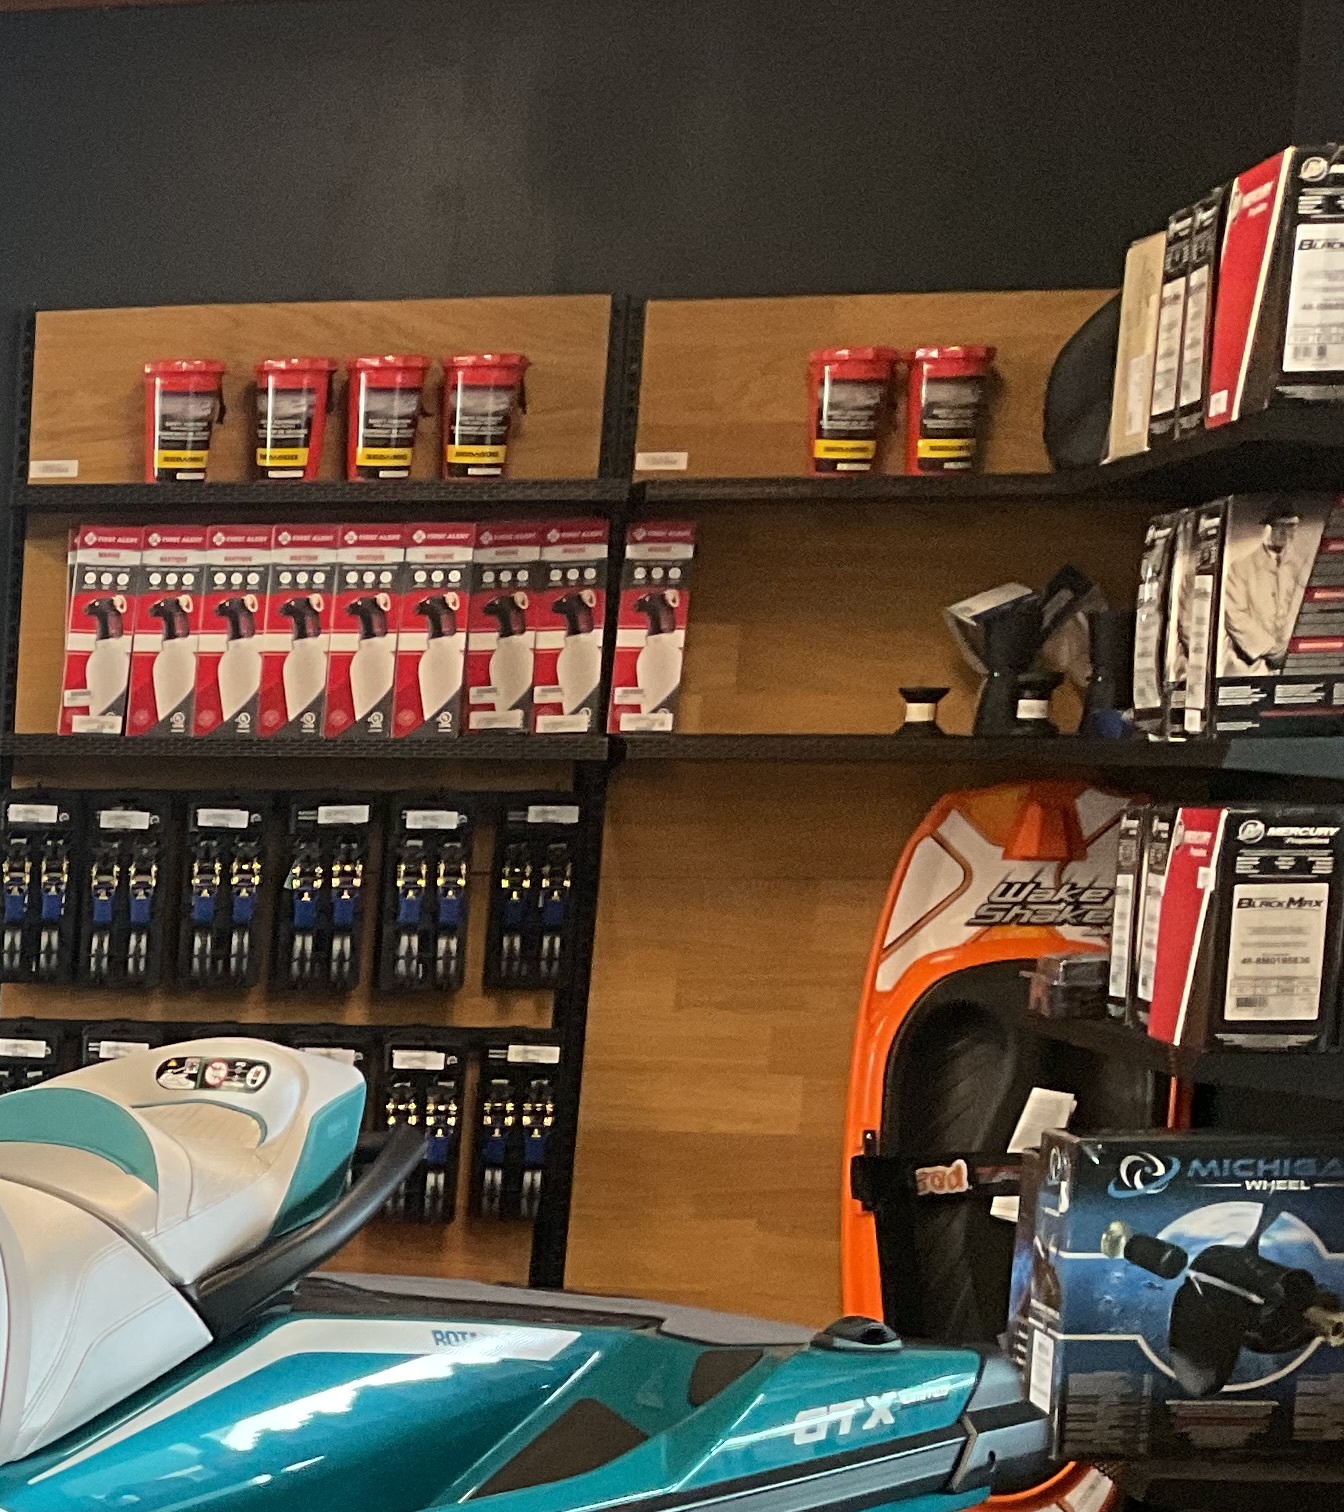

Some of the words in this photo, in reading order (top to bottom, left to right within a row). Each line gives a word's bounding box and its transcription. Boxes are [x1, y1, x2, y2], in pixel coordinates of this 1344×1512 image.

[1267, 827, 1340, 837] MERCURY
[987, 880, 1112, 904] Wake
[1244, 1180, 1311, 1193] WHEEL
[793, 1391, 898, 1445] GTX
